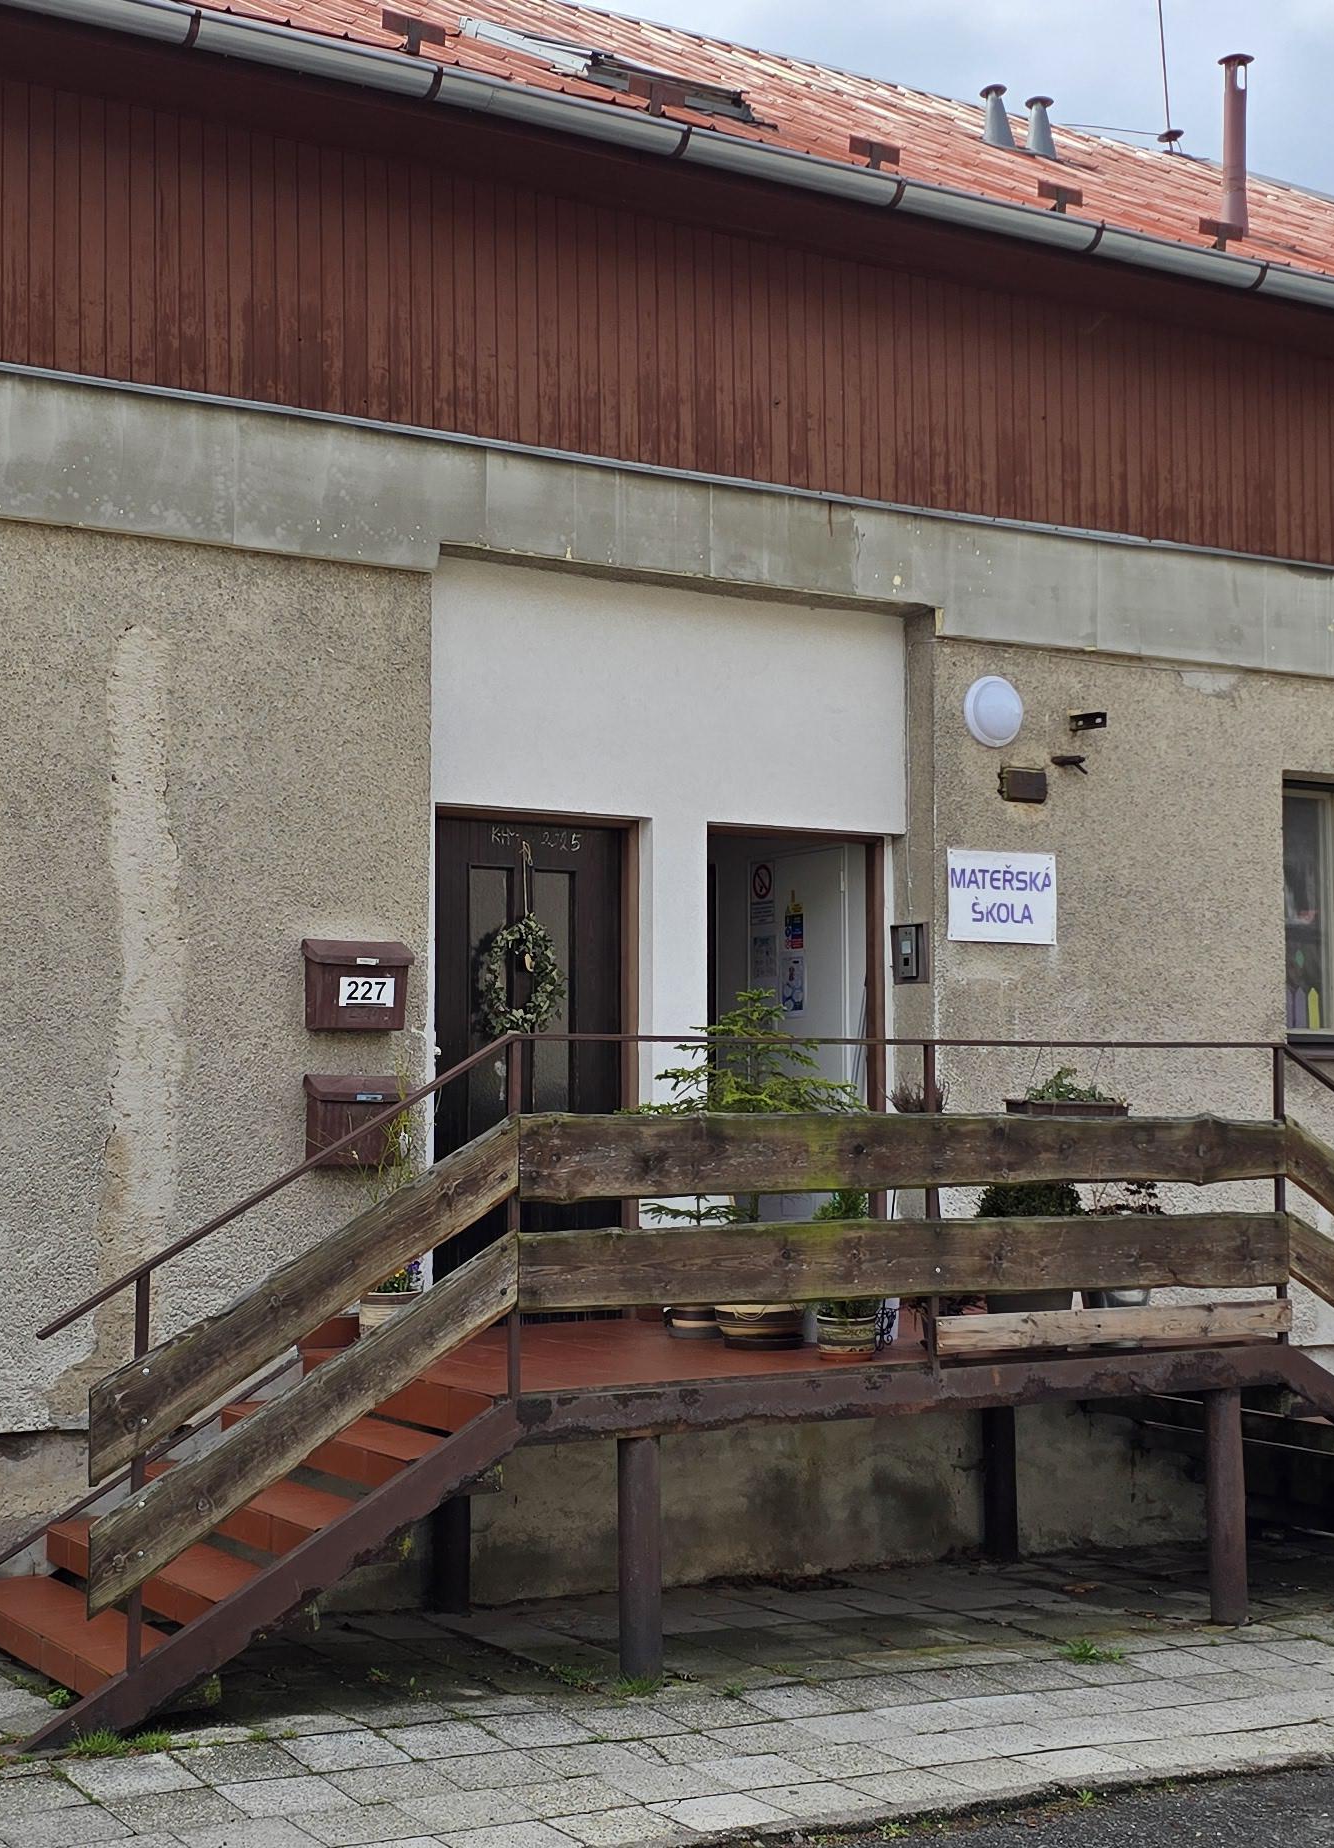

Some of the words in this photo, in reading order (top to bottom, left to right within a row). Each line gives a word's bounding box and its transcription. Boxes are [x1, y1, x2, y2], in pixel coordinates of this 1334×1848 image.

[950, 864, 1052, 893] MATEŘSKÁ
[971, 896, 1034, 925] ŠKOLA
[346, 981, 387, 1001] 227
